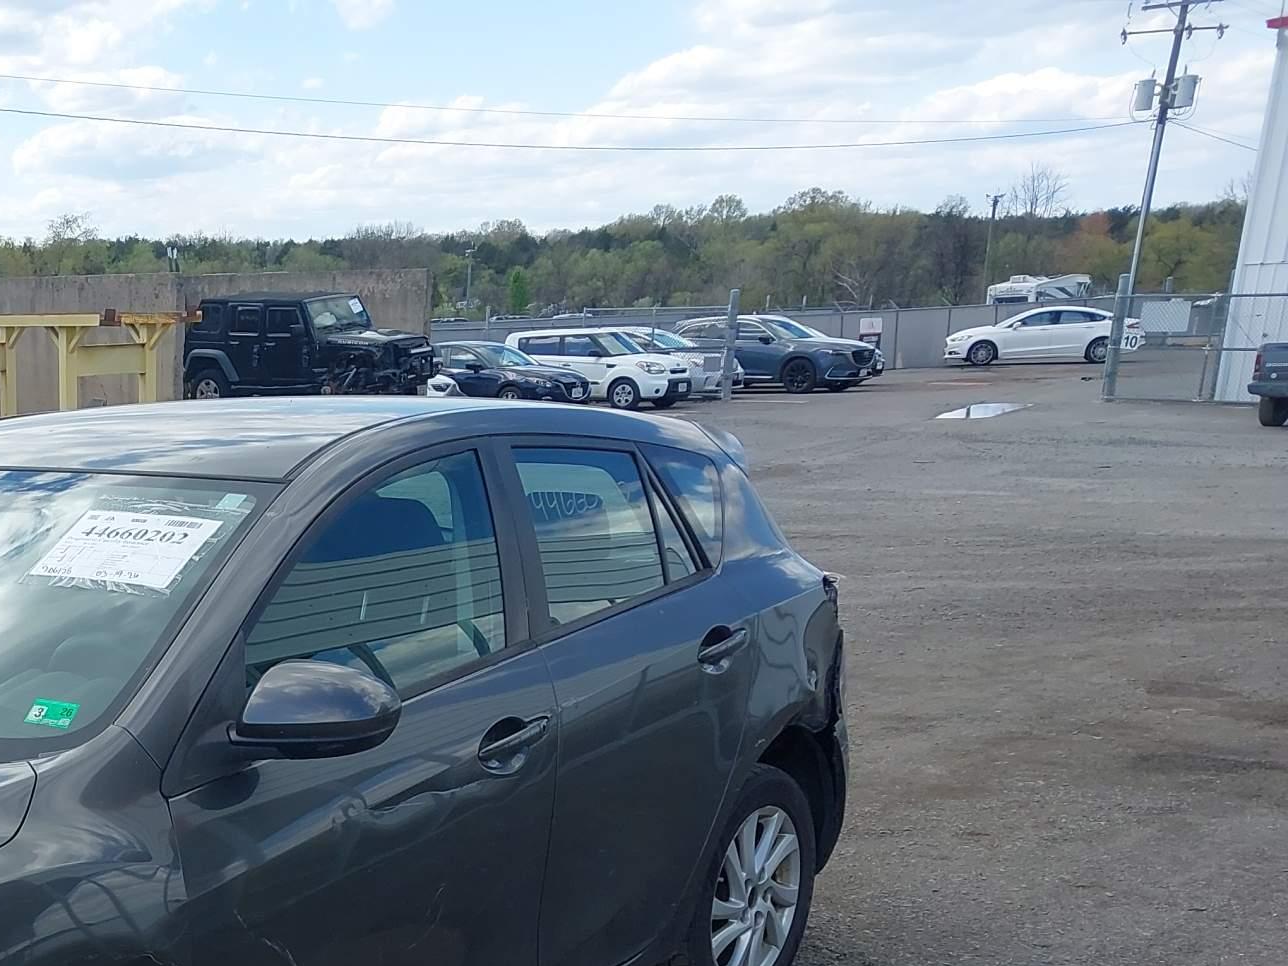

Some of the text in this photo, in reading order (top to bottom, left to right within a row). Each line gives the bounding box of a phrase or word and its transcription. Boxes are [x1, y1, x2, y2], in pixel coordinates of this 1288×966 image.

[1124, 335, 1138, 349] 10
[81, 525, 190, 545] 44660202
[34, 707, 73, 717] 3 26
